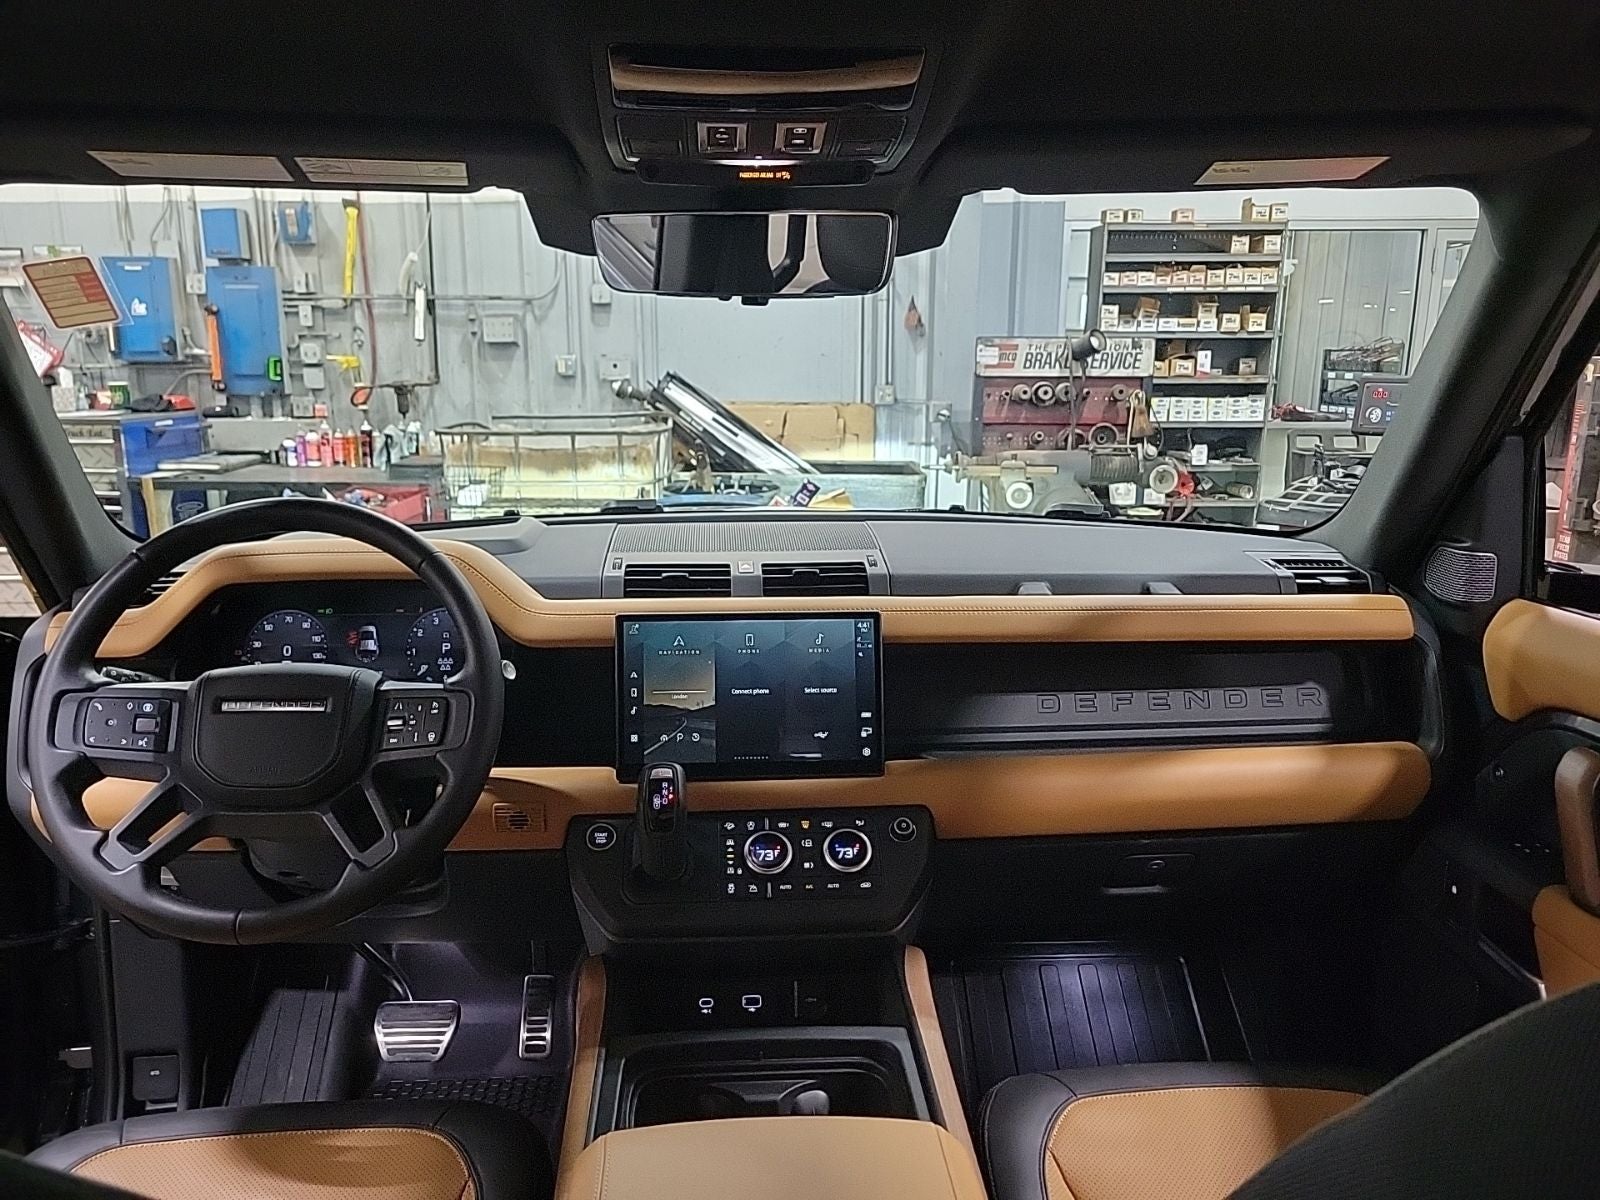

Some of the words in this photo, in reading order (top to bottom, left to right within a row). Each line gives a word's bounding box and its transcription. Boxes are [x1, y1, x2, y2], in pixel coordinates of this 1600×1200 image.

[417, 629, 424, 637] 2
[283, 645, 292, 657] 0
[442, 643, 451, 654] P
[753, 687, 770, 696] phone
[1036, 687, 1324, 714] DEFENDER
